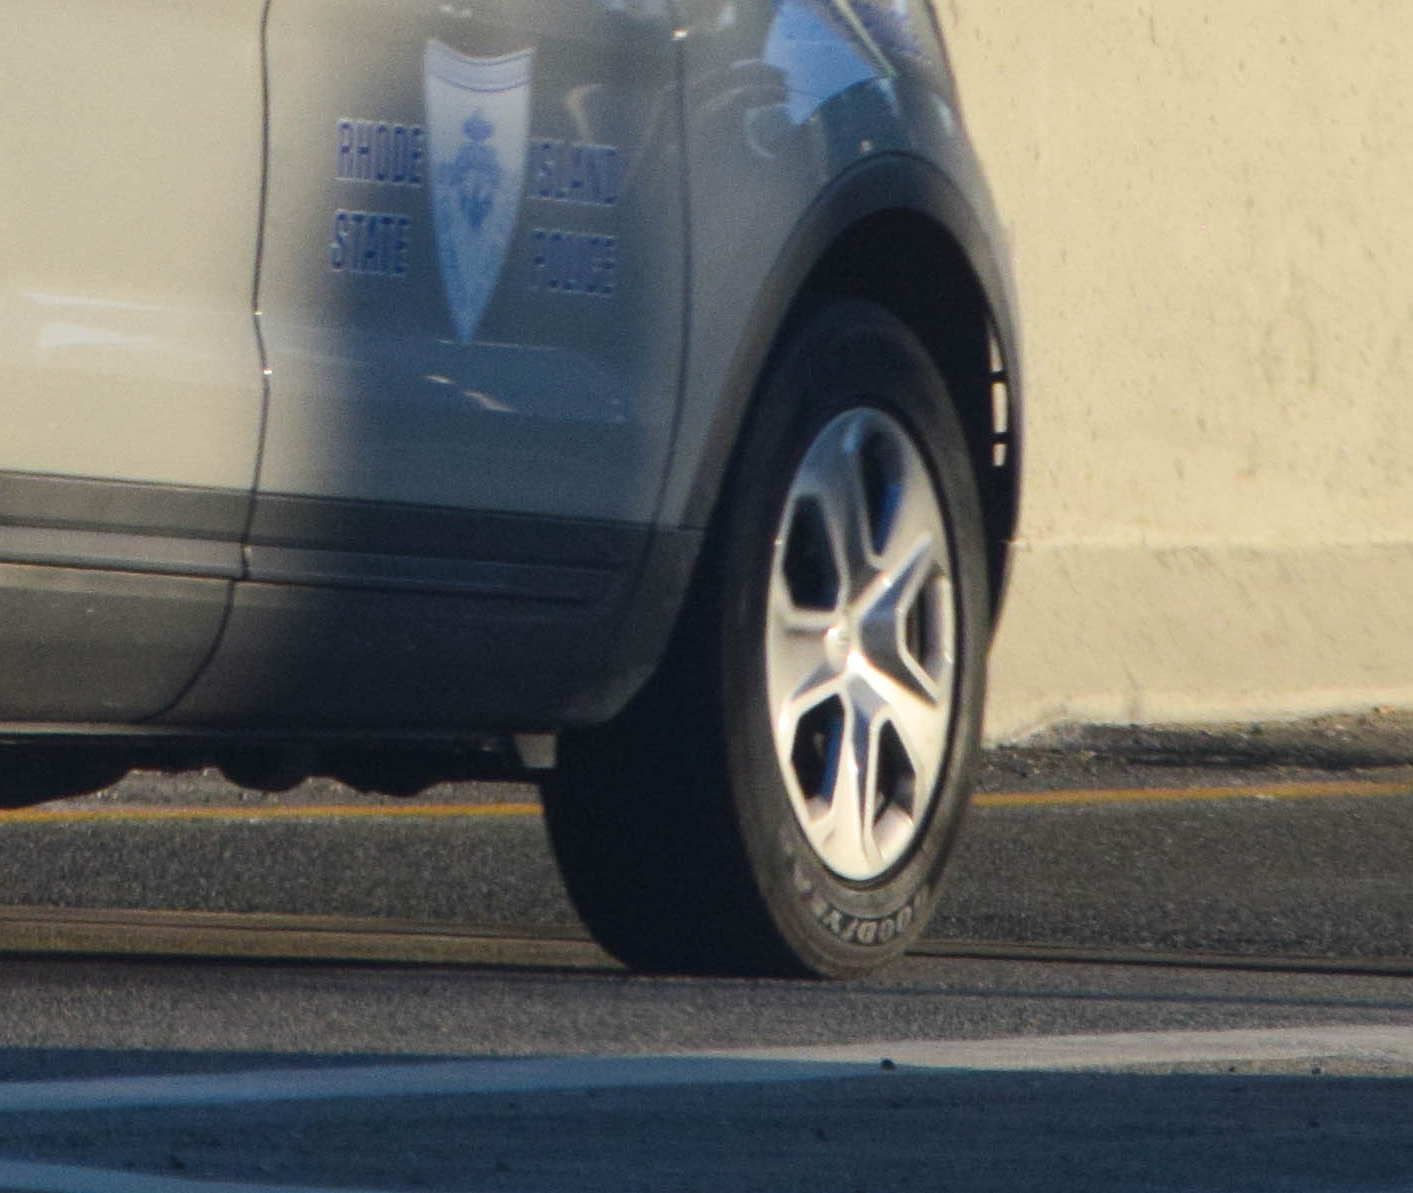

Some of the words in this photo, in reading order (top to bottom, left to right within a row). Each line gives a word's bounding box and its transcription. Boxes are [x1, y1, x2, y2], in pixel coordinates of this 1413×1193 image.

[334, 119, 423, 187] RHODE
[330, 209, 412, 277] STATE
[530, 228, 618, 297] POLICE
